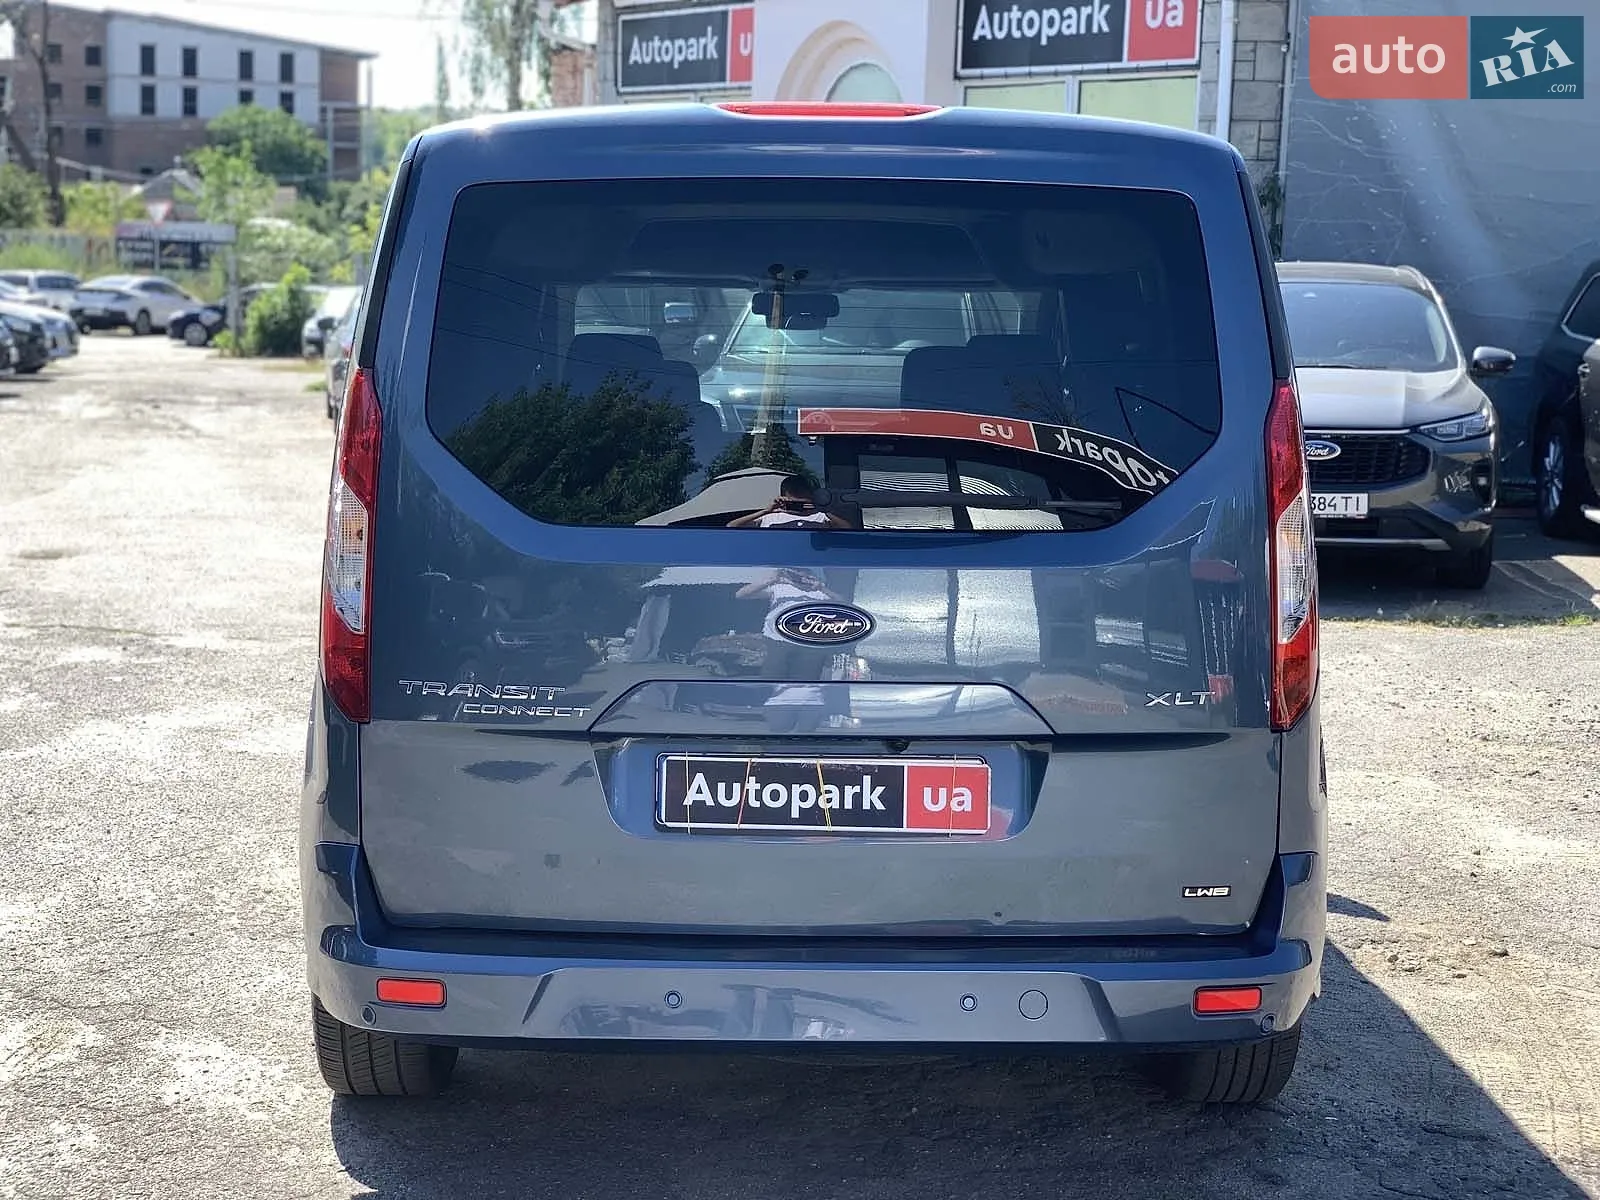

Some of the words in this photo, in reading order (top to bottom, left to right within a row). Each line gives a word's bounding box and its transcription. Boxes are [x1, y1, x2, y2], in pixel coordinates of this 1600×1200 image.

[972, 0, 1112, 46] Autopark
[628, 26, 719, 69] Autopark
[1305, 444, 1329, 456] Ford
[799, 612, 849, 634] Ford
[399, 680, 566, 700] TRANSIT
[1144, 691, 1216, 706] XLT
[462, 703, 592, 718] CONNECT
[682, 772, 886, 819] Autopark
[922, 786, 973, 812] ua
[1184, 887, 1230, 897] LWB
